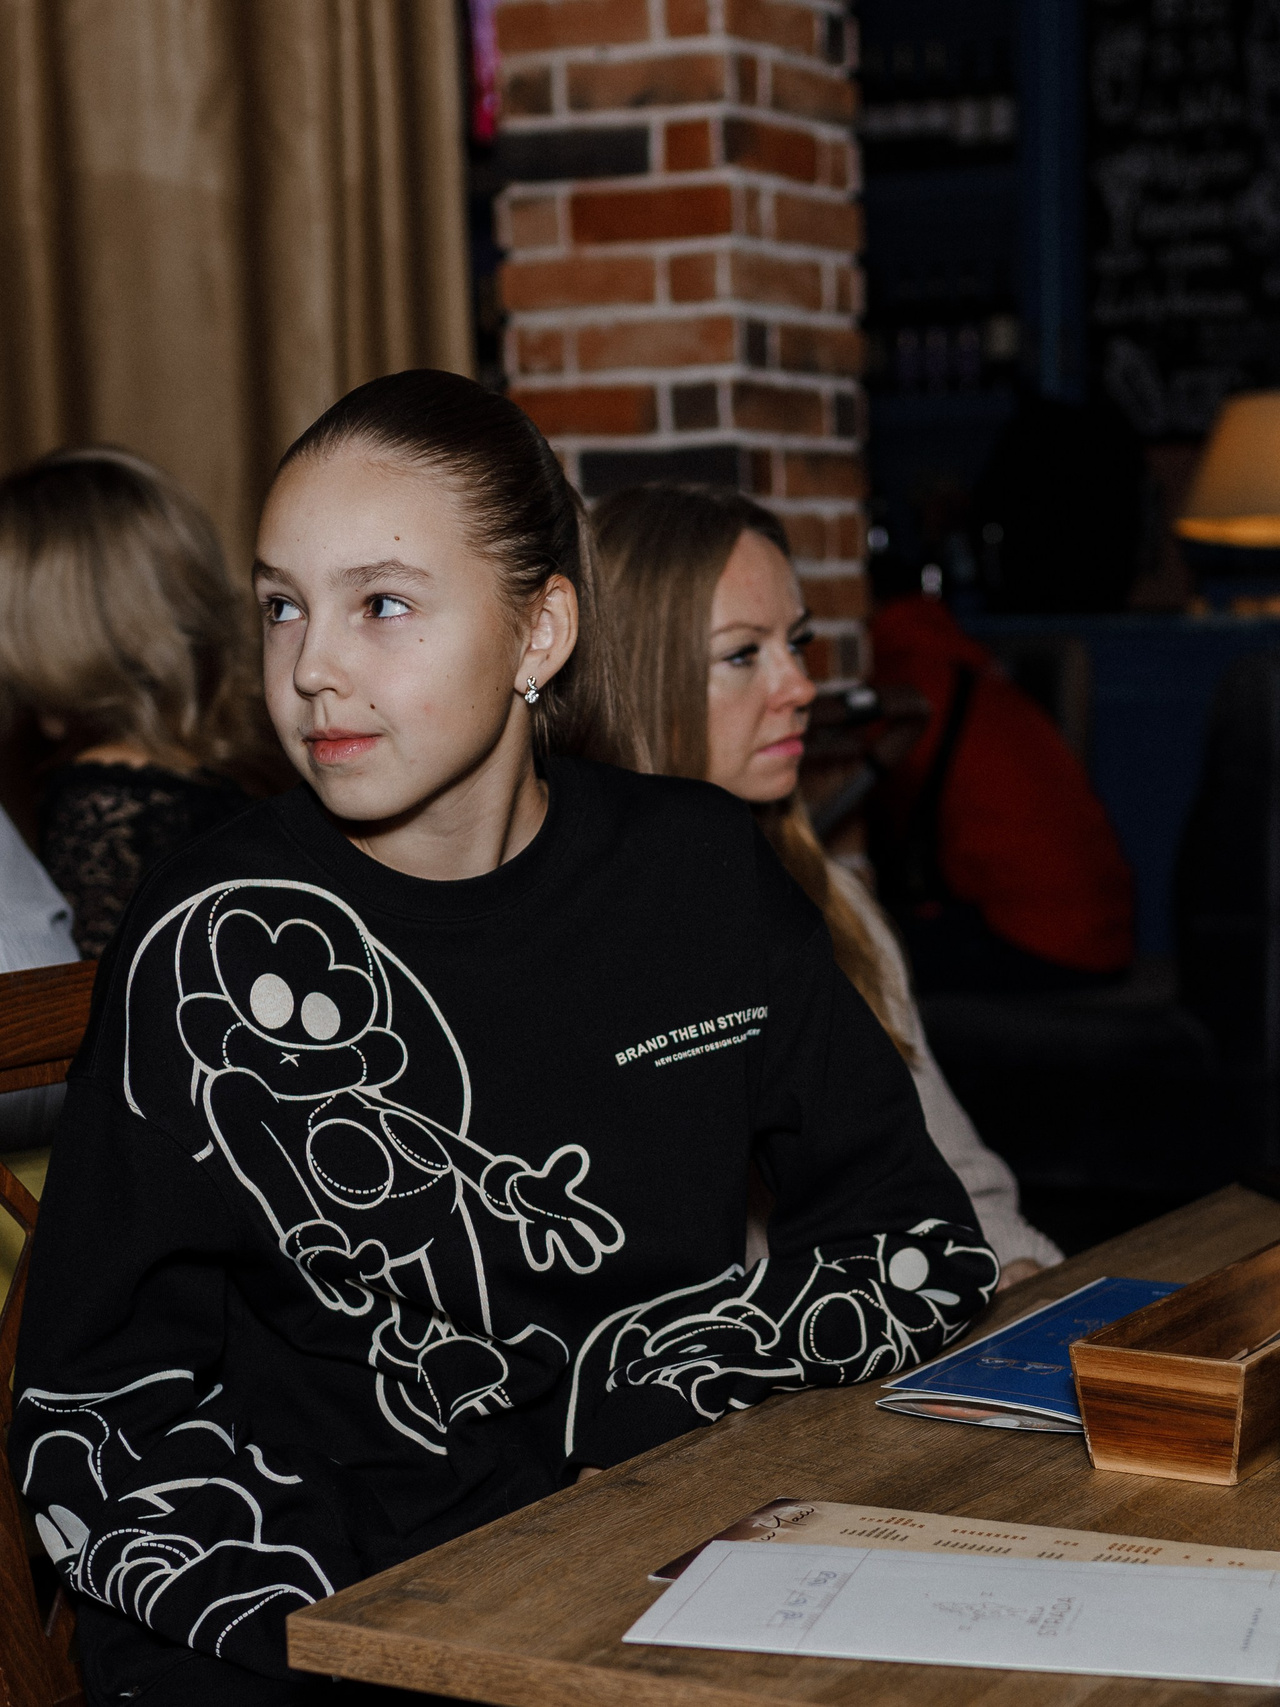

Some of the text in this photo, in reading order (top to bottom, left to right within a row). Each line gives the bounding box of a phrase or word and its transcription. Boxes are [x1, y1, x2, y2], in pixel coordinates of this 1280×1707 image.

[615, 1034, 668, 1067] BRAND
[668, 1024, 699, 1044] THE
[699, 1019, 716, 1036] IN
[654, 1055, 673, 1068] NEW
[704, 1037, 732, 1053] DESIGN
